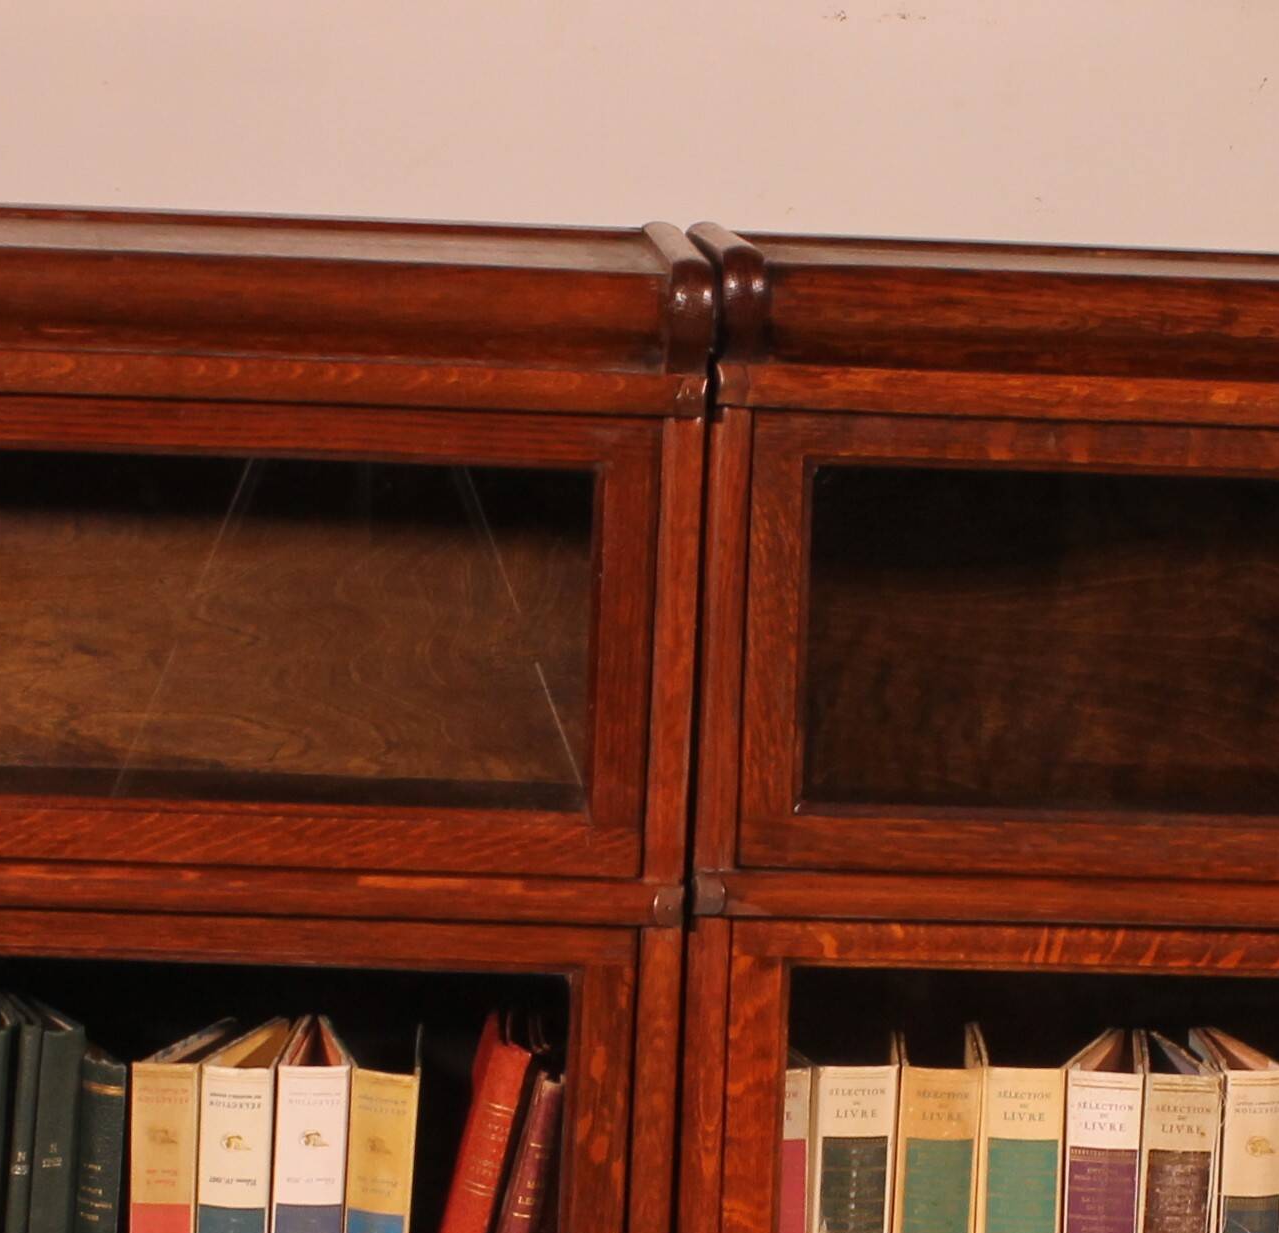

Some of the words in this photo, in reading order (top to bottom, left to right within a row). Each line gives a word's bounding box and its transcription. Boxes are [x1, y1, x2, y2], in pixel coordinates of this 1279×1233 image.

[835, 1109, 878, 1120] LIVRE
[1003, 1111, 1046, 1122] LIVRE
[1083, 1121, 1127, 1133] LIVRE
[1161, 1123, 1203, 1135] LIVRE
